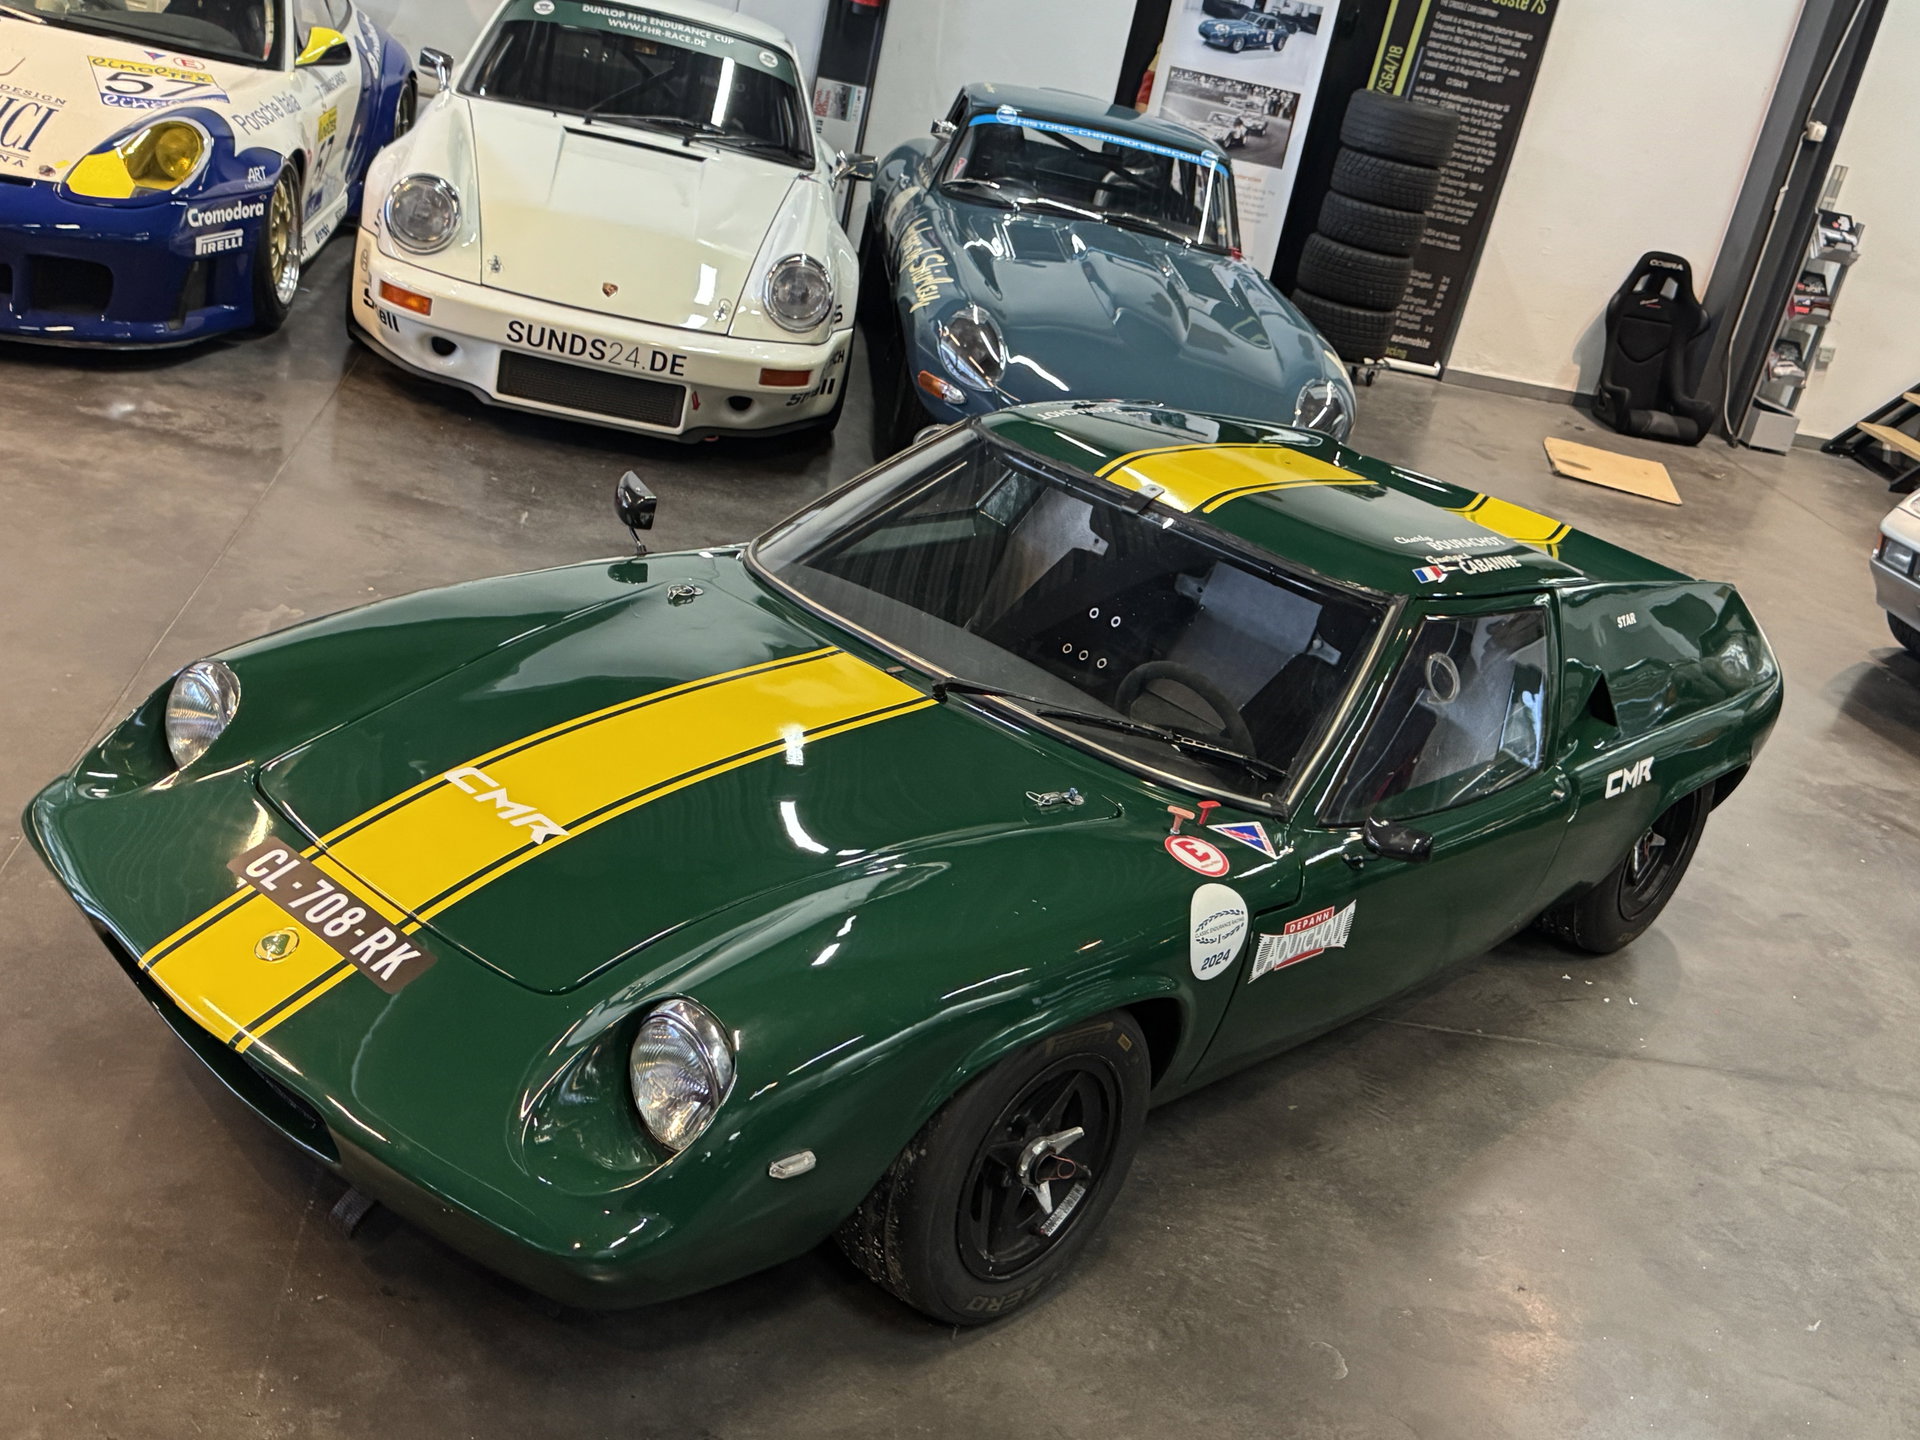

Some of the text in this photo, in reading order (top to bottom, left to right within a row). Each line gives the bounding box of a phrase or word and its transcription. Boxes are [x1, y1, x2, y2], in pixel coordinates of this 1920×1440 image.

[582, 4, 735, 45] DUNLOP FHR ENDURANCE CUP
[607, 18, 708, 47] WWW.FHR-RACE.DE
[0, 84, 67, 105] DESIGN
[104, 72, 211, 97] 57
[231, 98, 283, 136] Porsche
[248, 166, 265, 183] ART
[187, 200, 264, 228] Cromodora
[195, 228, 244, 255] PIRELLI
[1650, 259, 1684, 271] COBRA
[506, 320, 688, 377] SUNDS24.DE
[1425, 536, 1506, 551] BOURACHOT
[1459, 554, 1522, 575] CABANNE
[1617, 612, 1637, 629] STAR
[1605, 756, 1655, 799] CMR
[444, 766, 570, 846] CMR
[1290, 911, 1329, 933] DEPANN
[1200, 949, 1231, 972] 2024
